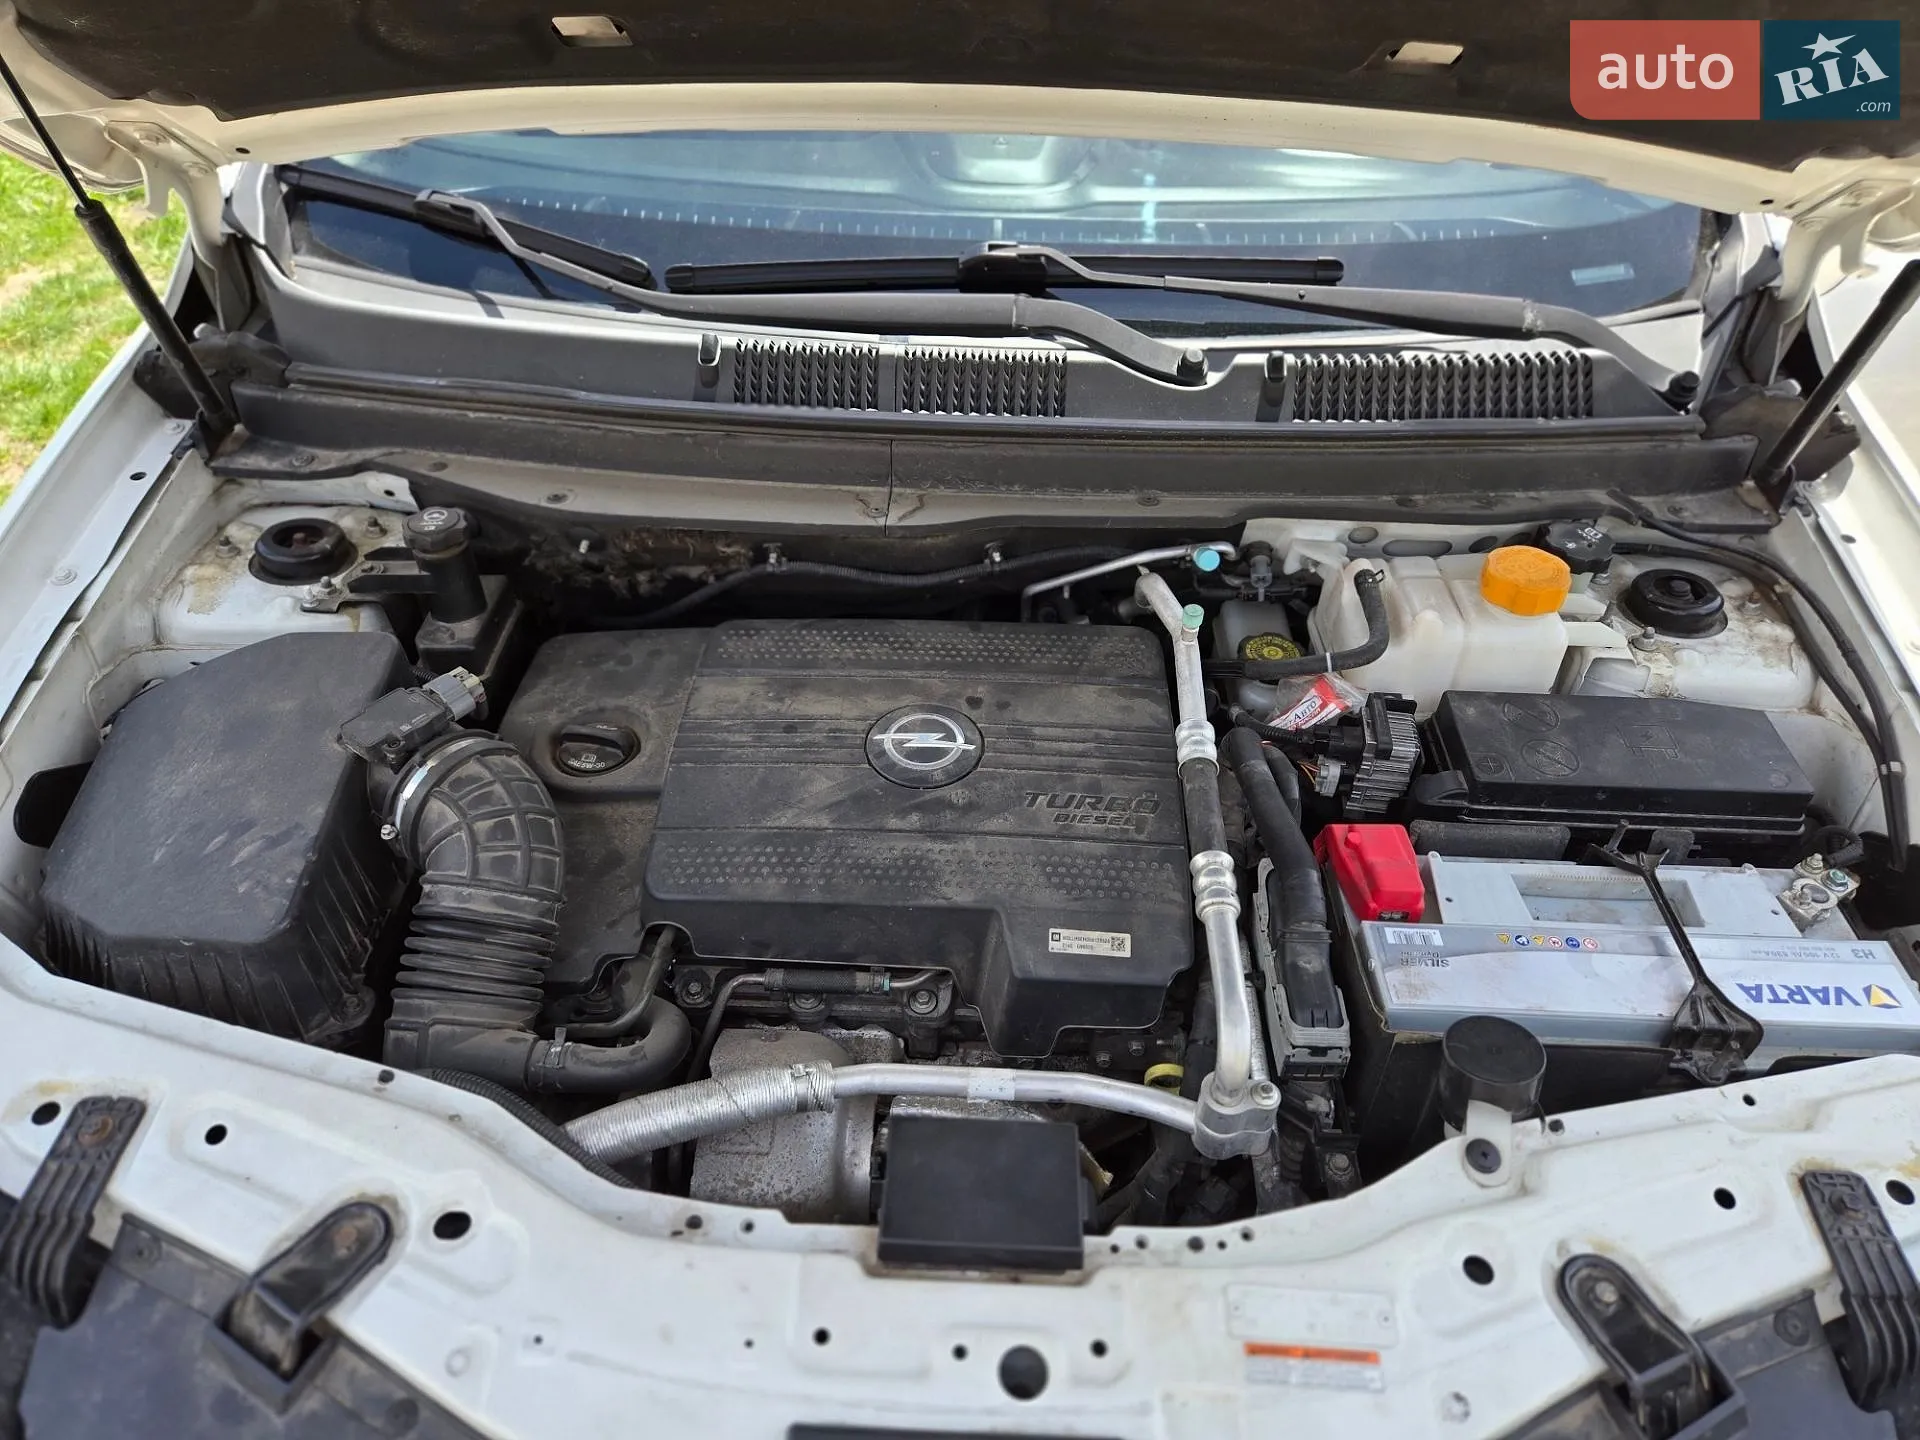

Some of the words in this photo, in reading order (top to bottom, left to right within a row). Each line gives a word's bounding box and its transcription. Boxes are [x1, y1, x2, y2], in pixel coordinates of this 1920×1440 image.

[1025, 791, 1161, 816] TURBO
[1053, 812, 1136, 826] DIESEL
[1401, 959, 1449, 968] SILVER
[1736, 983, 1861, 1006] VARTA
